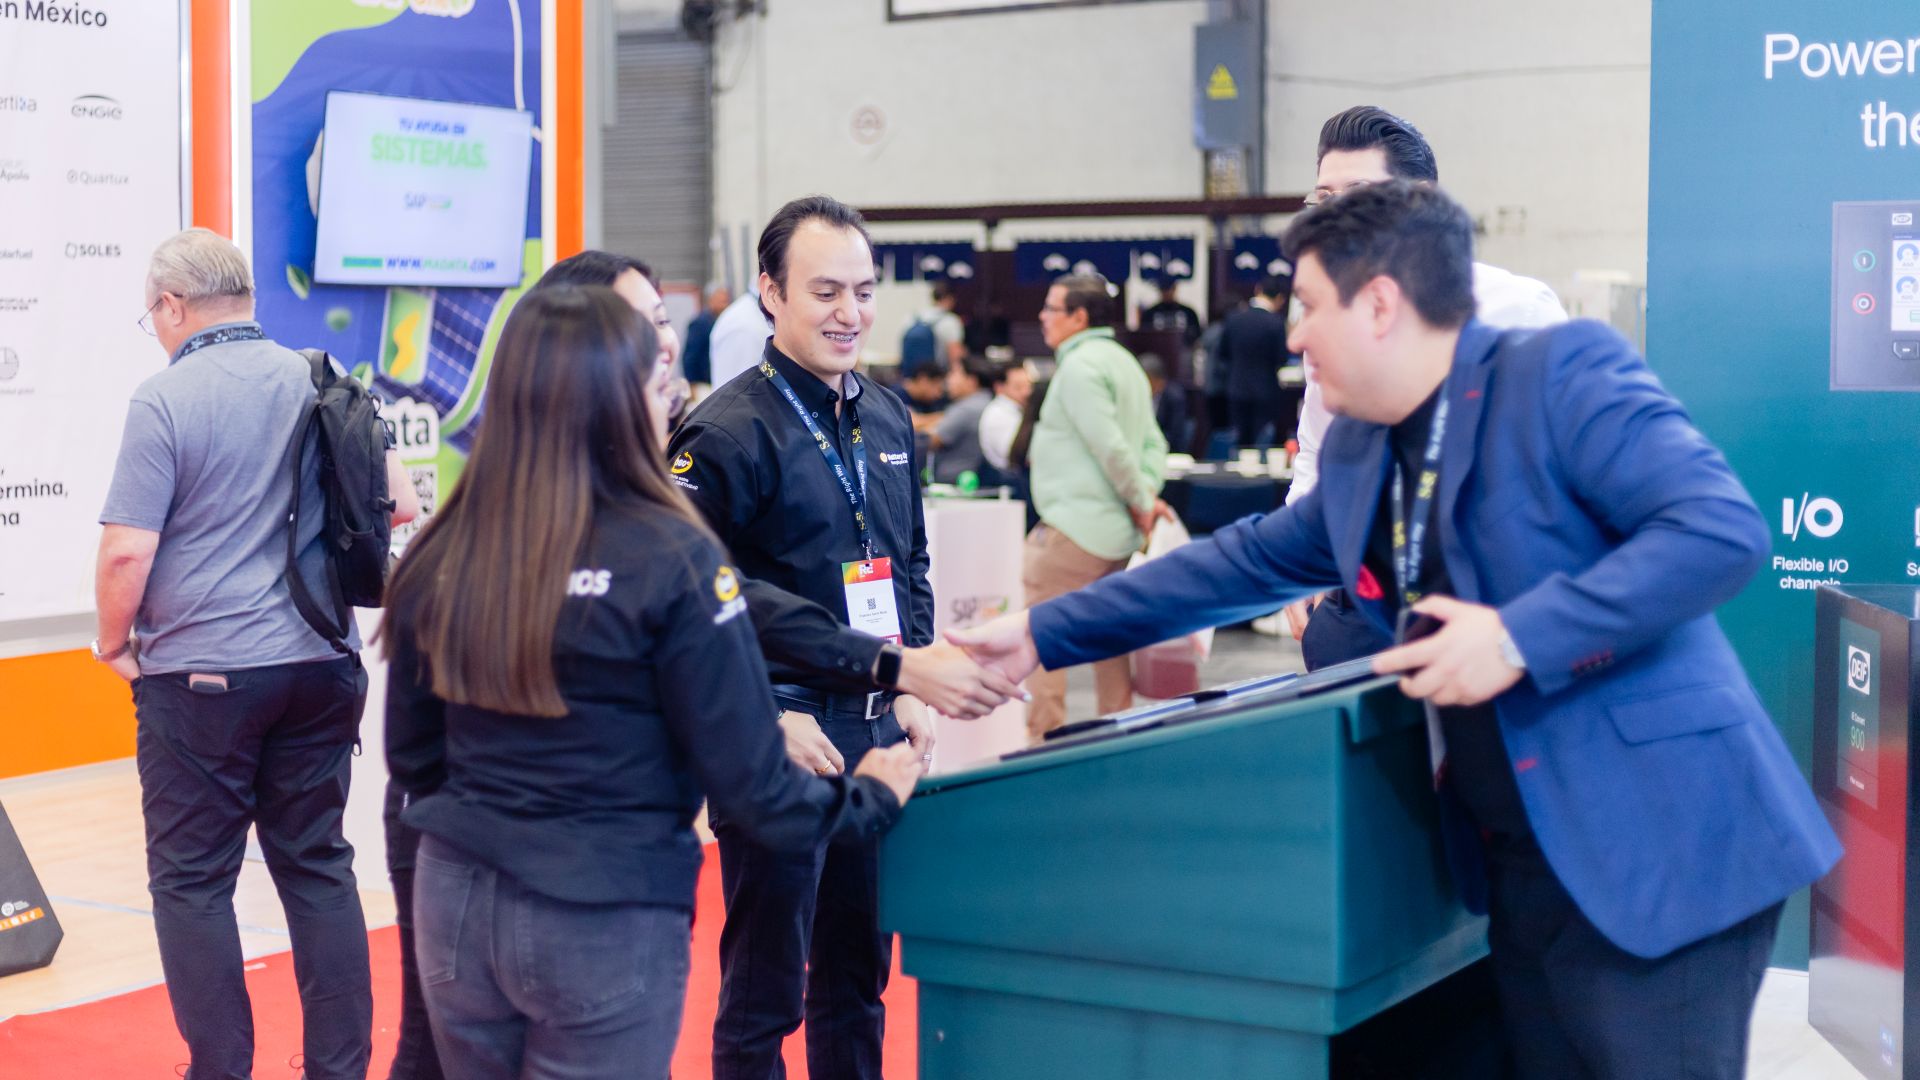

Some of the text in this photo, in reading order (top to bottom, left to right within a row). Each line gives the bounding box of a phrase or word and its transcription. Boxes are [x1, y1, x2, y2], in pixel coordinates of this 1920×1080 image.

[26, 0, 107, 27] México
[1782, 491, 1844, 542] I/O
[1773, 556, 1849, 573] Flexible I/O
[1851, 657, 1868, 682] DEIF
